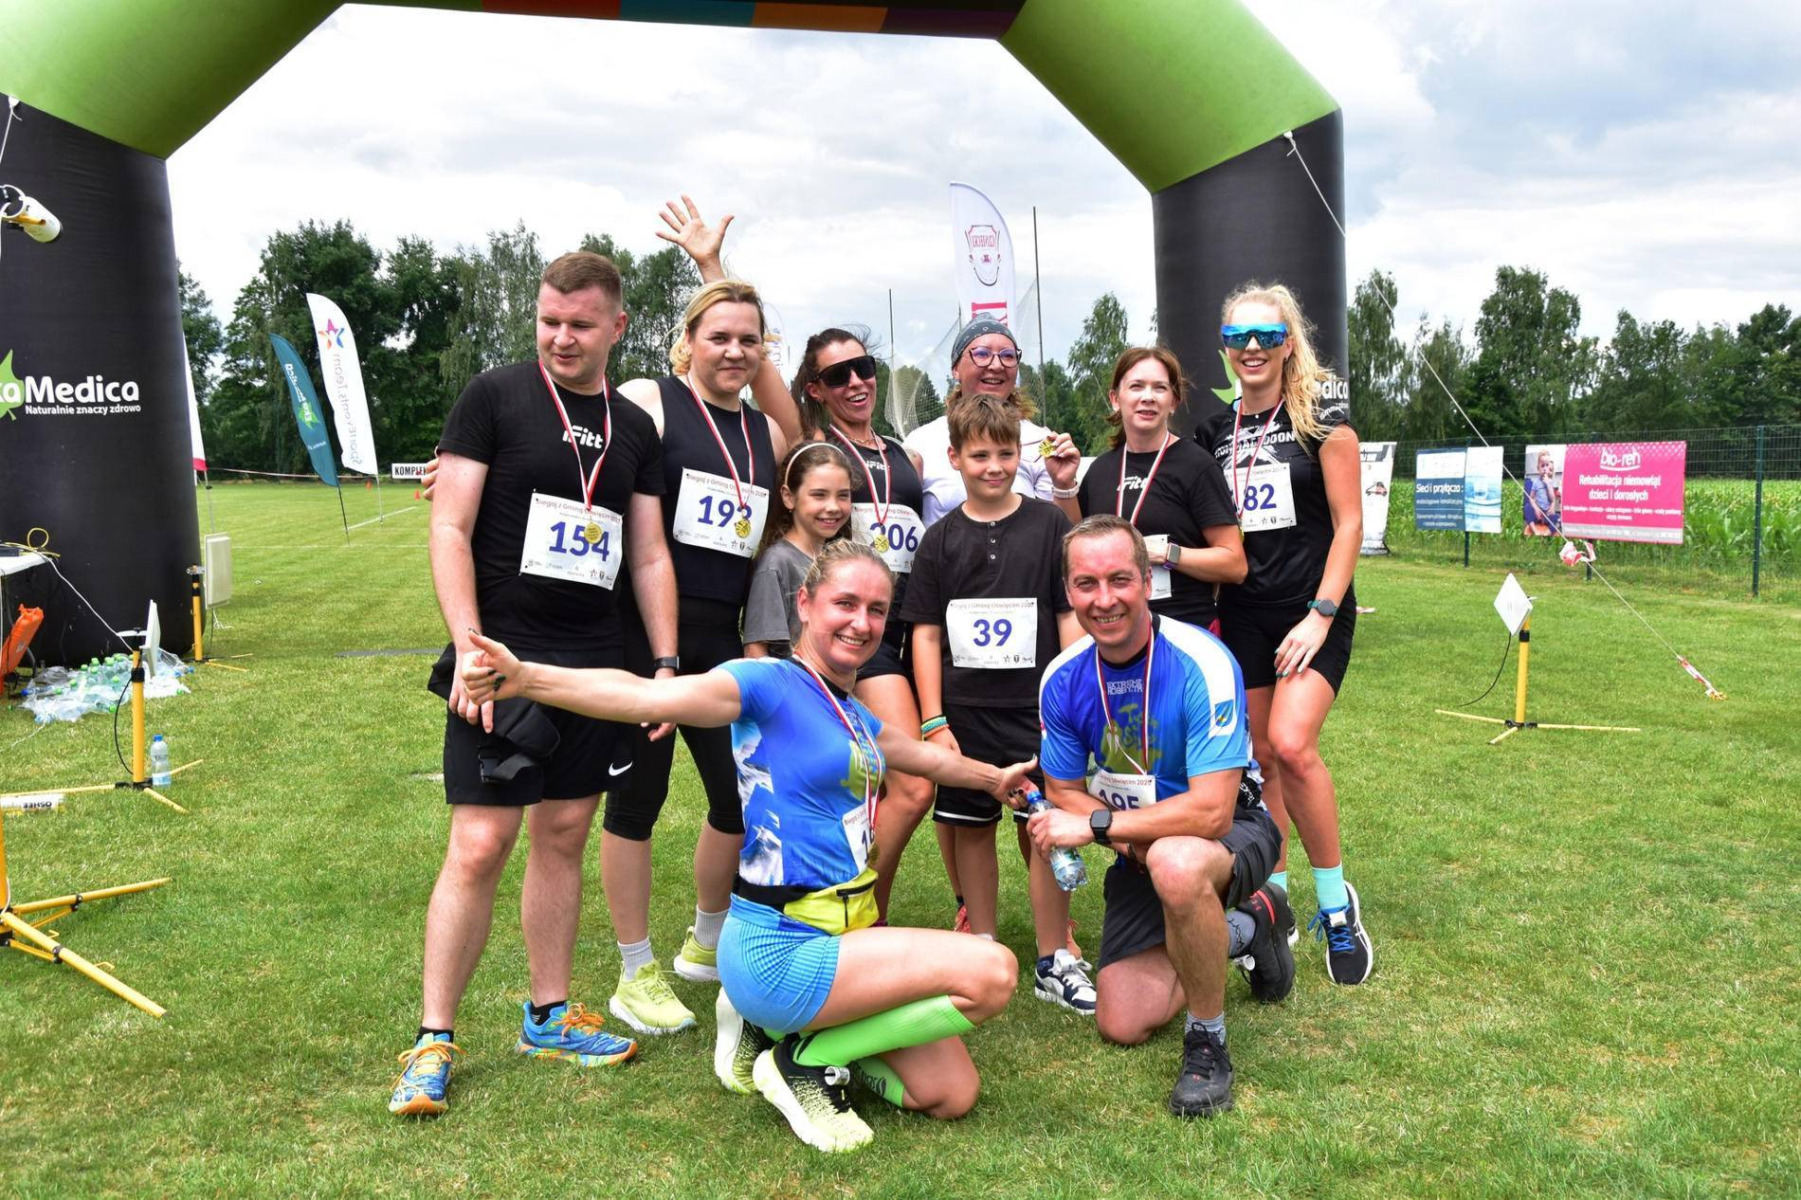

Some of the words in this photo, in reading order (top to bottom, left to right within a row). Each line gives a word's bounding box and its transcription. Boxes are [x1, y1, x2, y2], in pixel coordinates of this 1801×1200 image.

[0, 375, 140, 404] aMedica
[25, 405, 75, 415] Naturalnie
[76, 406, 108, 416] znaczy
[109, 404, 142, 413] zdrowo
[1244, 484, 1277, 511] 82
[549, 521, 609, 562] 154
[973, 618, 1013, 647] 39
